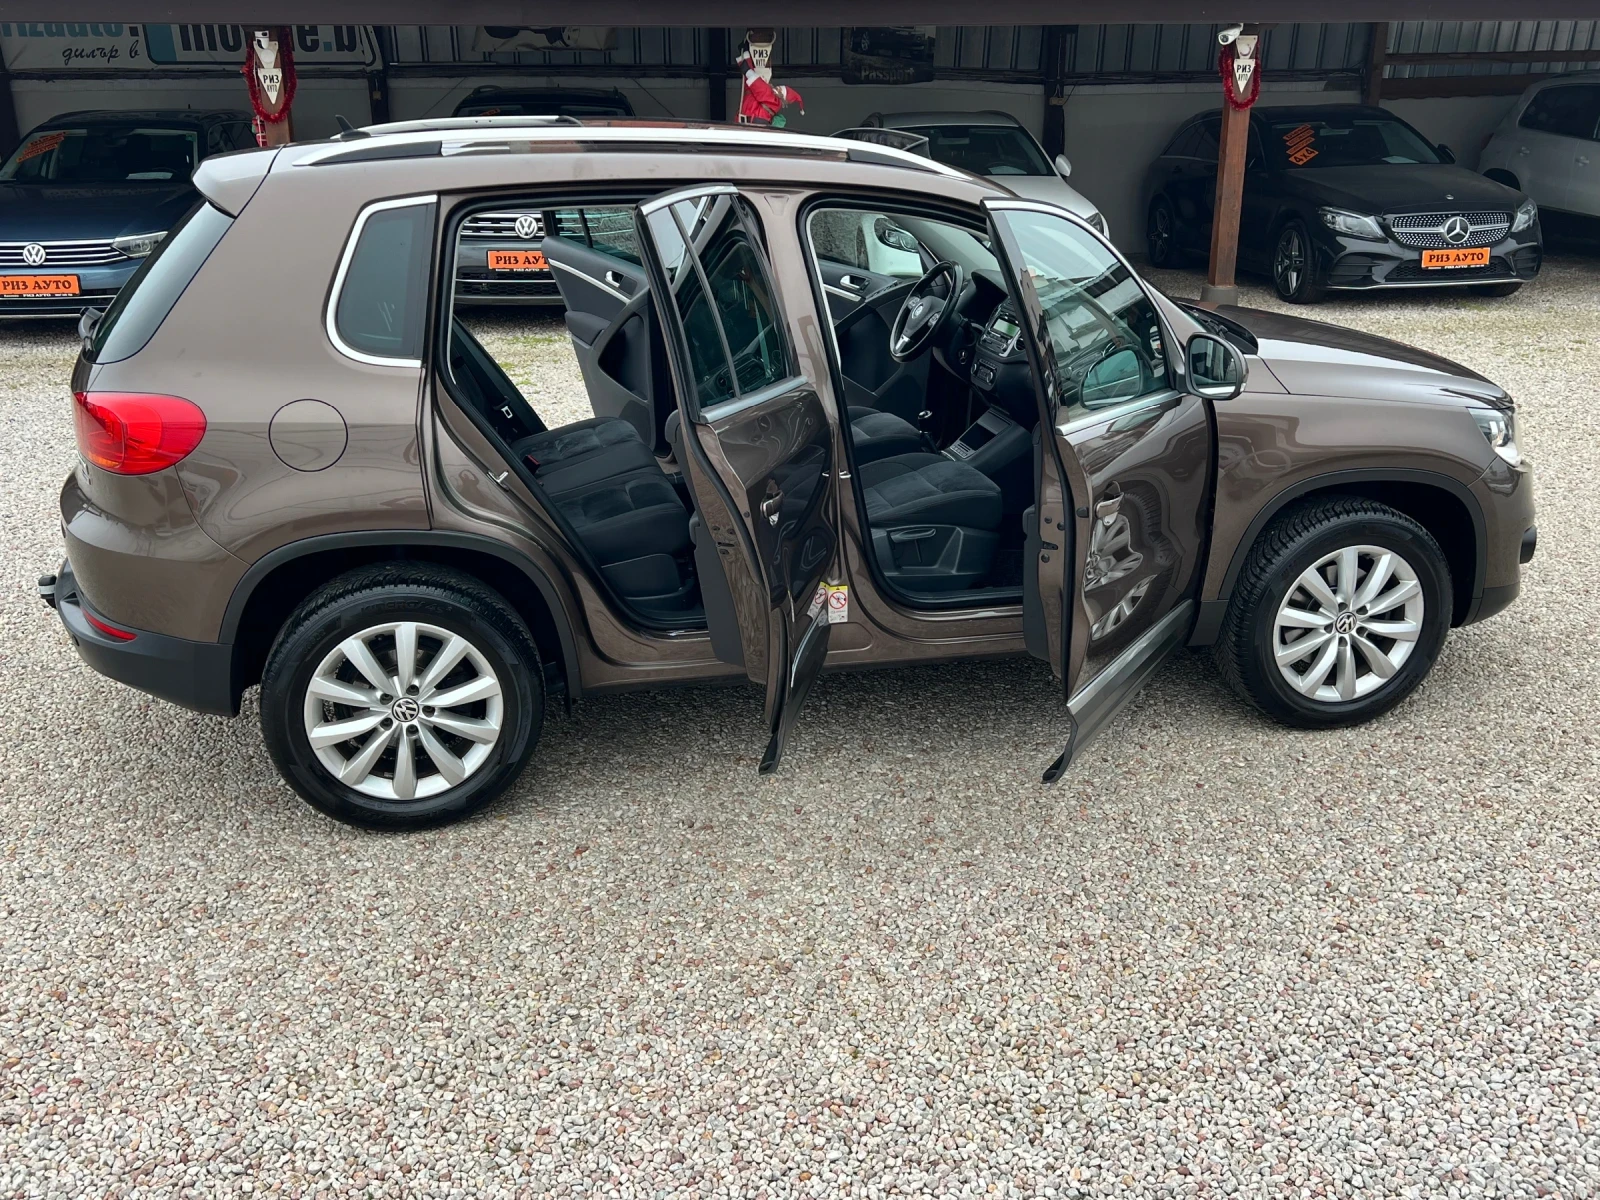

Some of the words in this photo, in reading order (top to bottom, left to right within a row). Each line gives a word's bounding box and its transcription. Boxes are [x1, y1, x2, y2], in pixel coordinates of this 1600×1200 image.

[62, 44, 121, 66] дилър
[753, 49, 768, 58] РИЗ
[1236, 64, 1252, 73] РИЗ
[262, 74, 280, 84] РИЗ
[861, 65, 915, 83] Passport
[495, 256, 519, 264] РИЗ
[522, 256, 547, 264] АУТ
[1429, 254, 1450, 263] РИЗ
[1453, 253, 1484, 262] АУТО
[2, 280, 28, 290] РИЗ
[33, 280, 72, 289] АУТО
